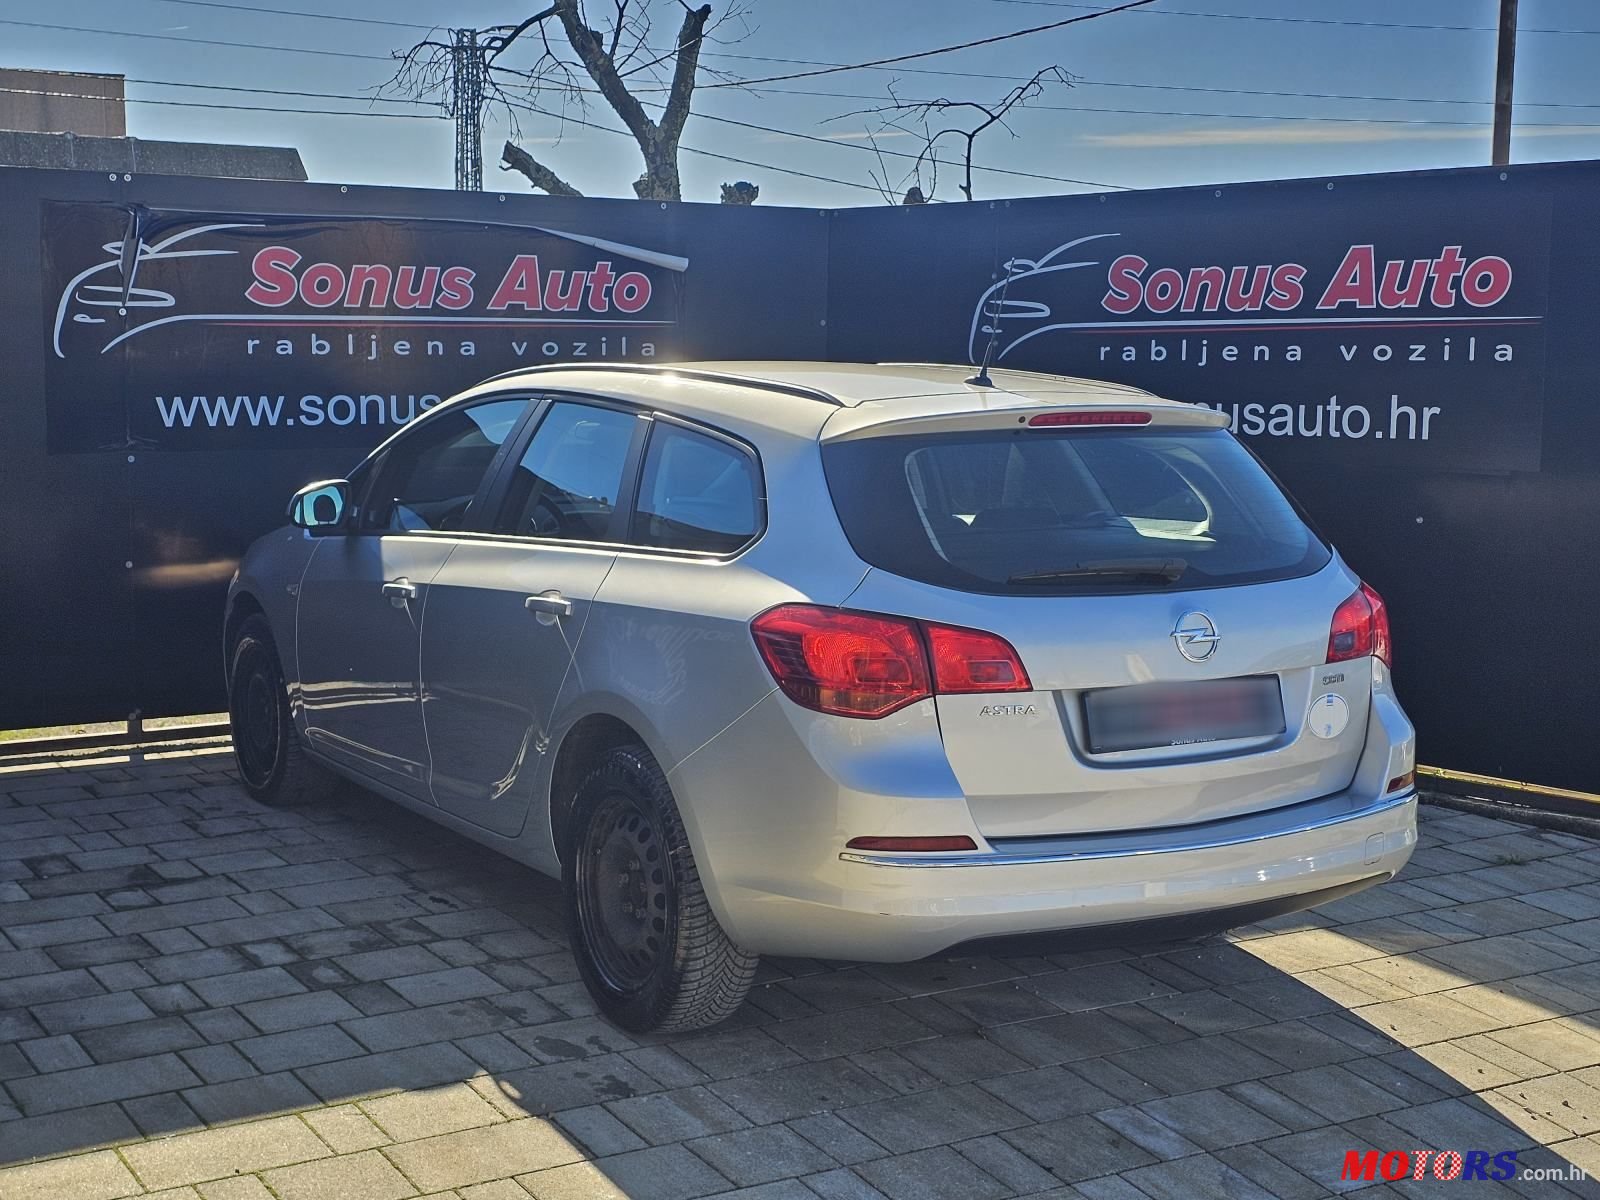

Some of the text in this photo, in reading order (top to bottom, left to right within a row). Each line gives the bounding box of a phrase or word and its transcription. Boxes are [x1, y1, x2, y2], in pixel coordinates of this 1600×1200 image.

[244, 245, 652, 314] Sonus Auto
[1101, 244, 1513, 315] Sonus Auto
[246, 334, 656, 361] rabljena vozila
[1099, 336, 1515, 367] rabljena vozila
[1196, 394, 1442, 441] usauto.hr
[979, 704, 1037, 717] ASTRA
